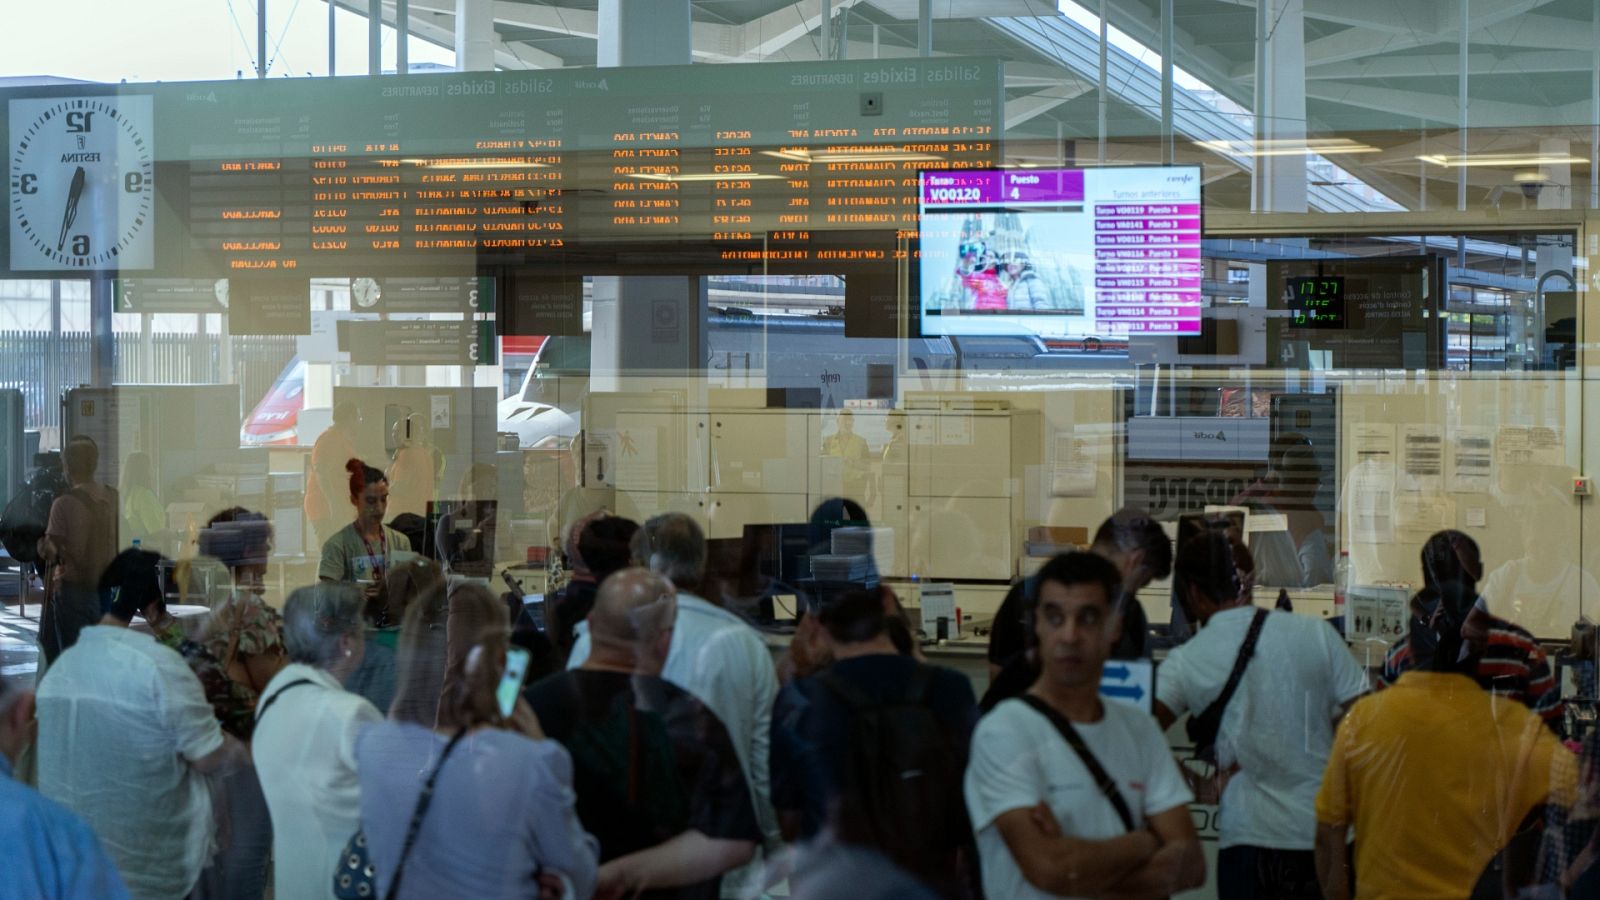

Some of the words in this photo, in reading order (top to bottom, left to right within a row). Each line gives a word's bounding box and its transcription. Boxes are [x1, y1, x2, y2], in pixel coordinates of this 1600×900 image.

[1010, 175, 1040, 184] Puesto
[1010, 188, 1020, 199] 4
[1112, 190, 1139, 199] Turnos
[1141, 190, 1181, 199] anteriores
